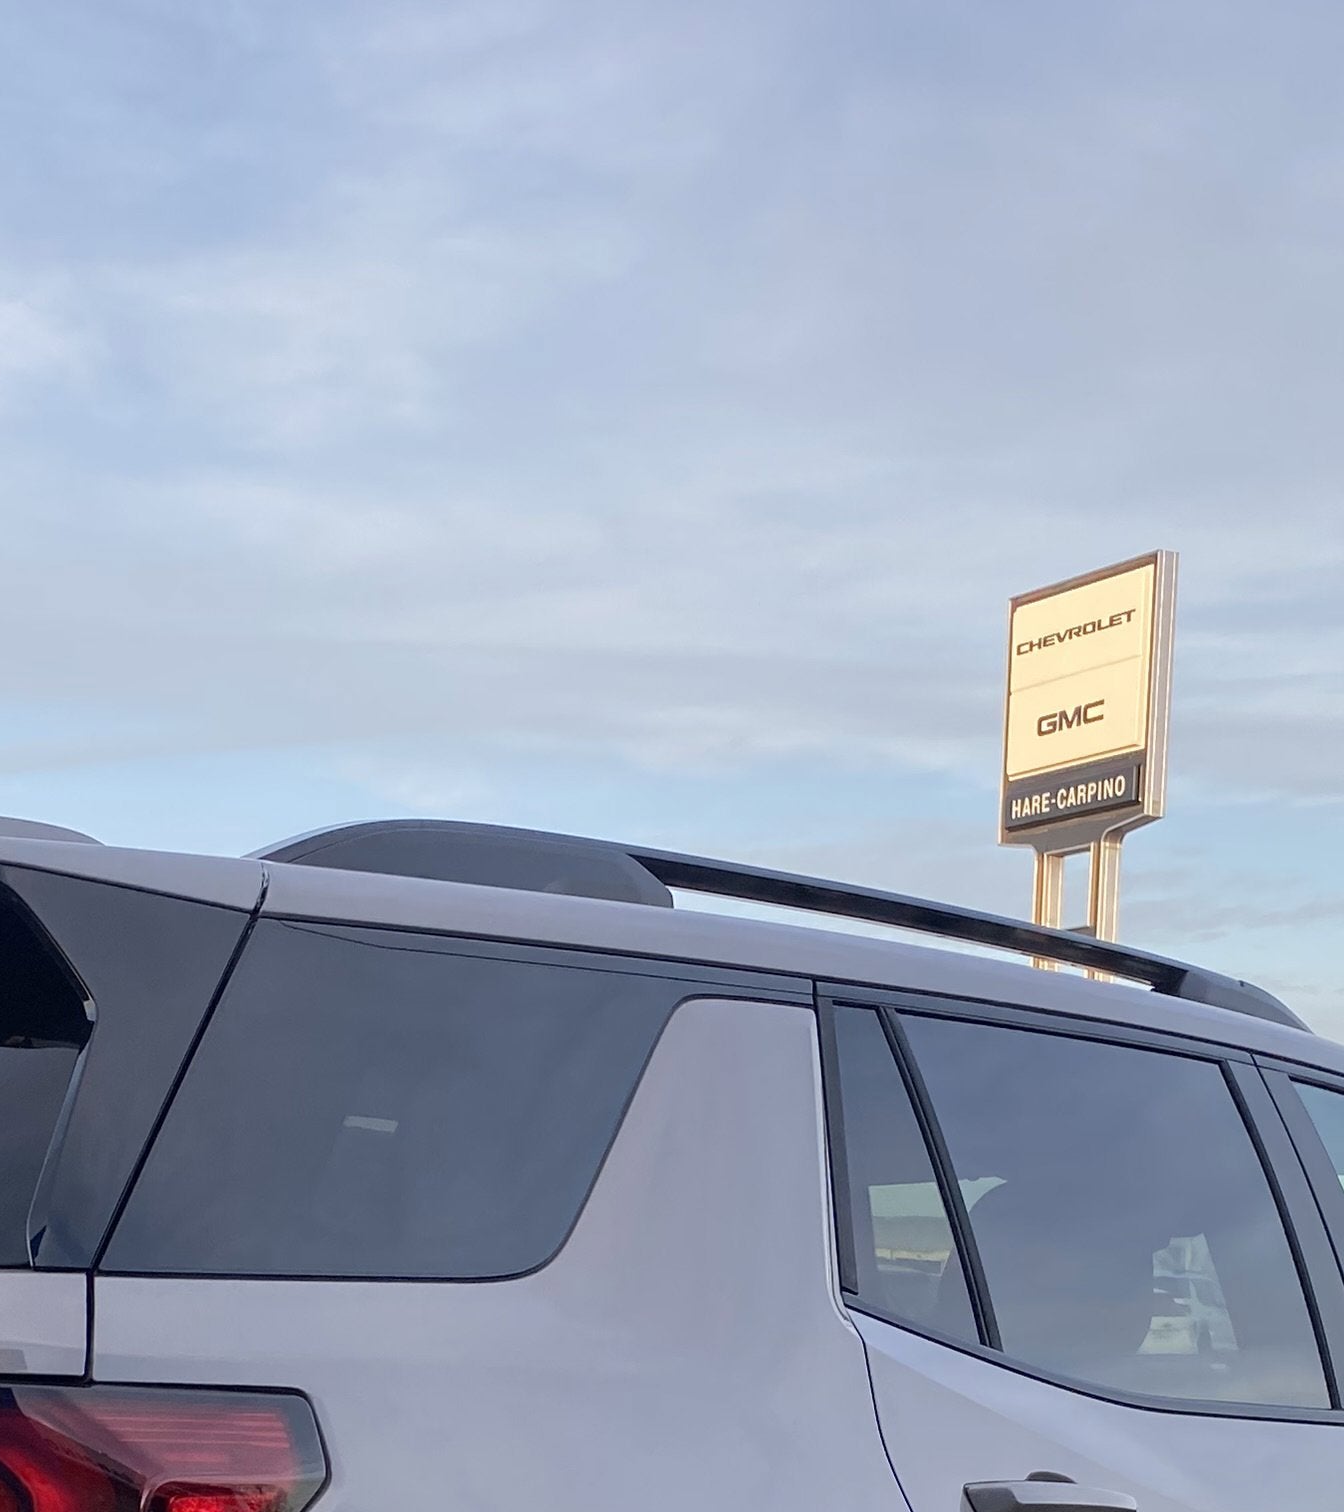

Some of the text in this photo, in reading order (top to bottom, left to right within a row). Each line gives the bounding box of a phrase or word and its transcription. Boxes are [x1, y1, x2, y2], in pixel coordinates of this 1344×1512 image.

[1016, 609, 1137, 656] CHEVROLET
[1037, 698, 1105, 737] GMC
[1011, 775, 1126, 819] HARE-CARPINO
